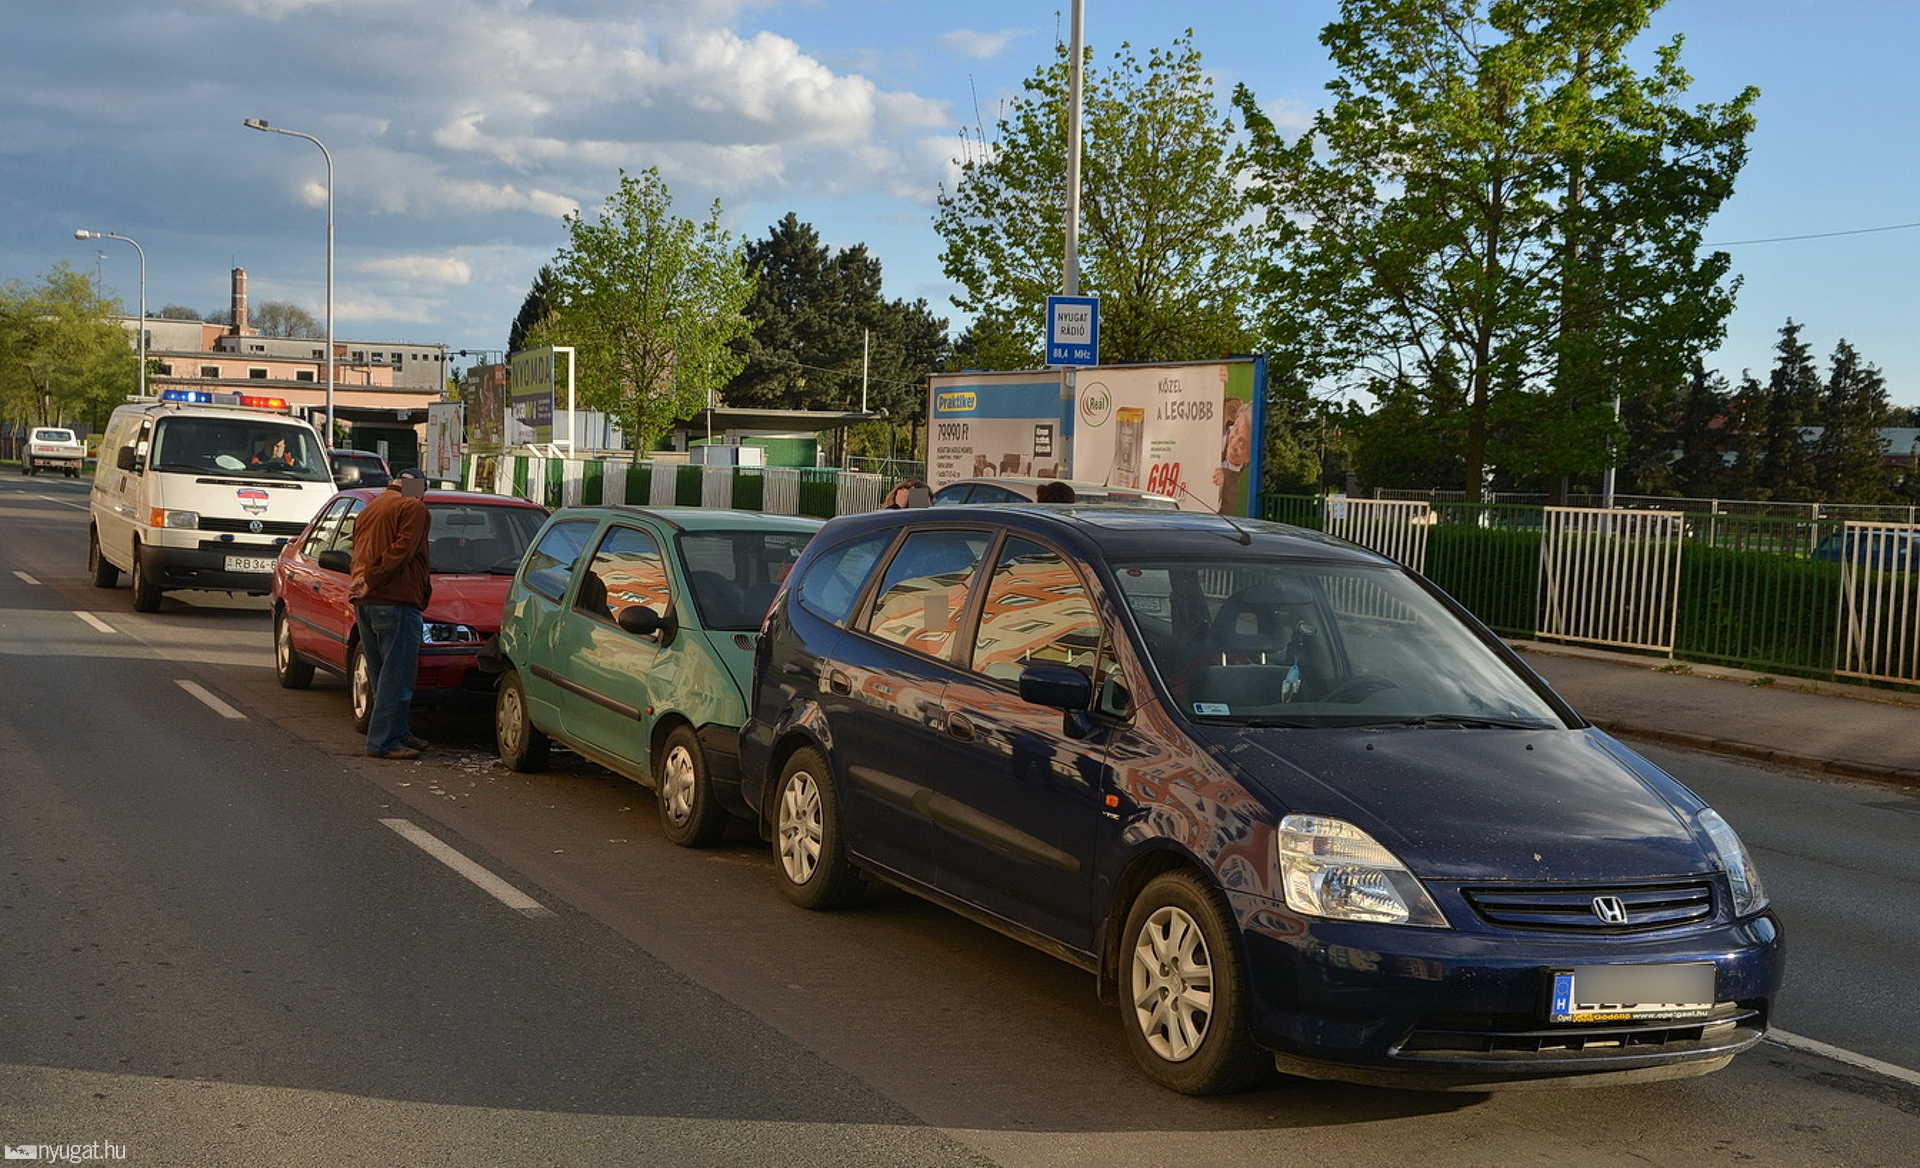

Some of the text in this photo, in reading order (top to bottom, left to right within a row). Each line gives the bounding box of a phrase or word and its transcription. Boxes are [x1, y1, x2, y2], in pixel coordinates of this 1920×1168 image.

[1057, 312, 1088, 321] NYUGAT
[1164, 400, 1214, 421] LEGJOBB
[1556, 998, 1567, 1010] H
